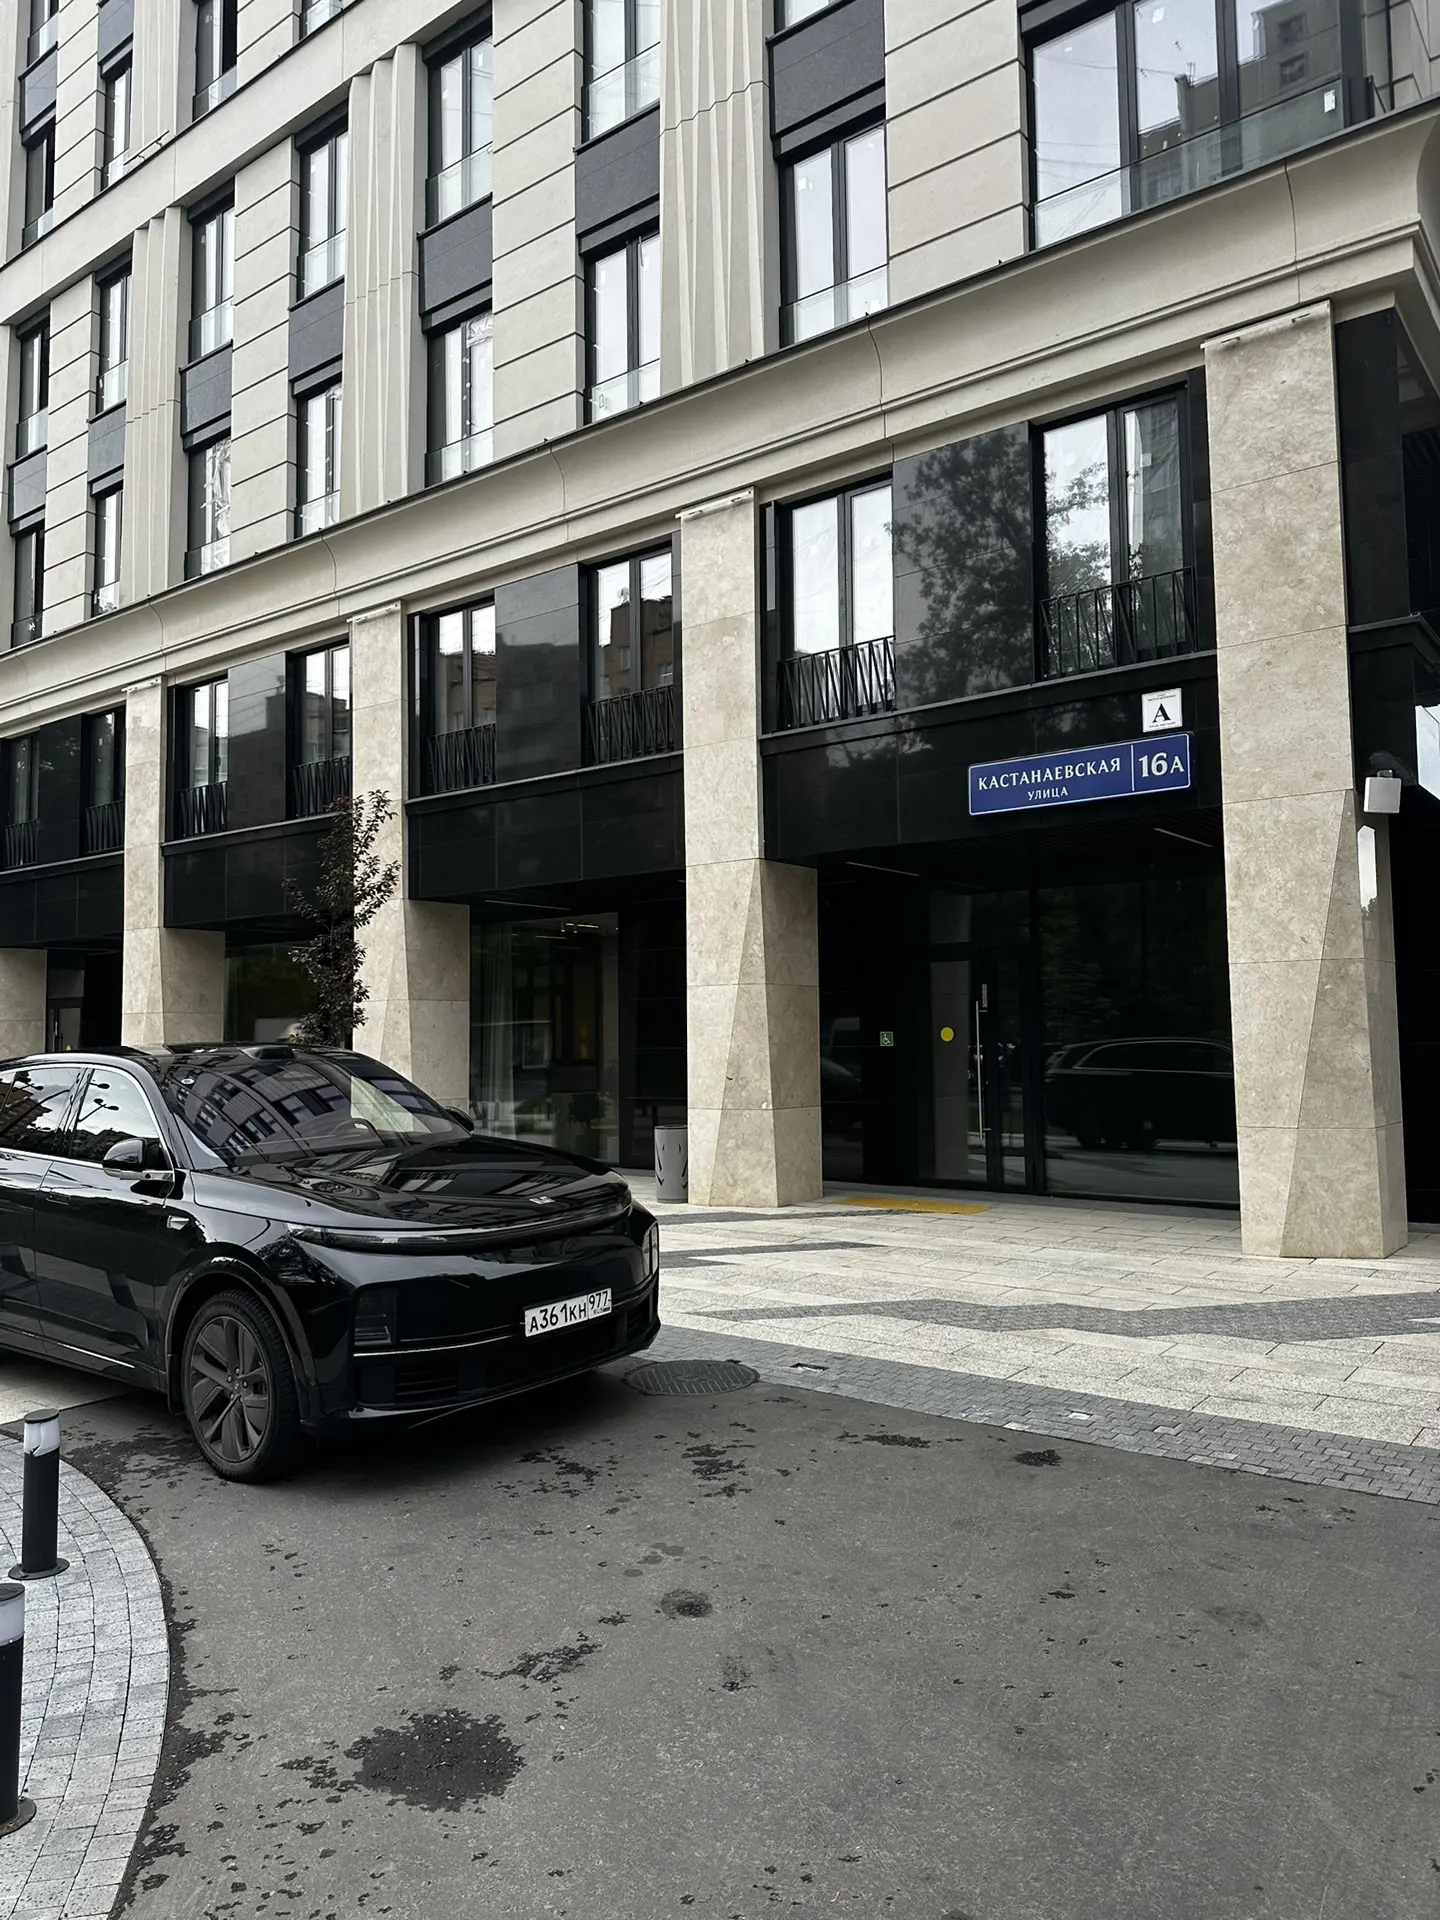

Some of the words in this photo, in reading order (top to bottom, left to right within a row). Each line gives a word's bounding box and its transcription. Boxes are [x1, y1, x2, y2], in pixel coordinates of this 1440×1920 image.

[1152, 703, 1171, 723] А
[978, 757, 1121, 790] КАСТАНАЕВСКАЯ
[1138, 752, 1185, 777] 16А
[1027, 786, 1068, 800] УЛИЦА
